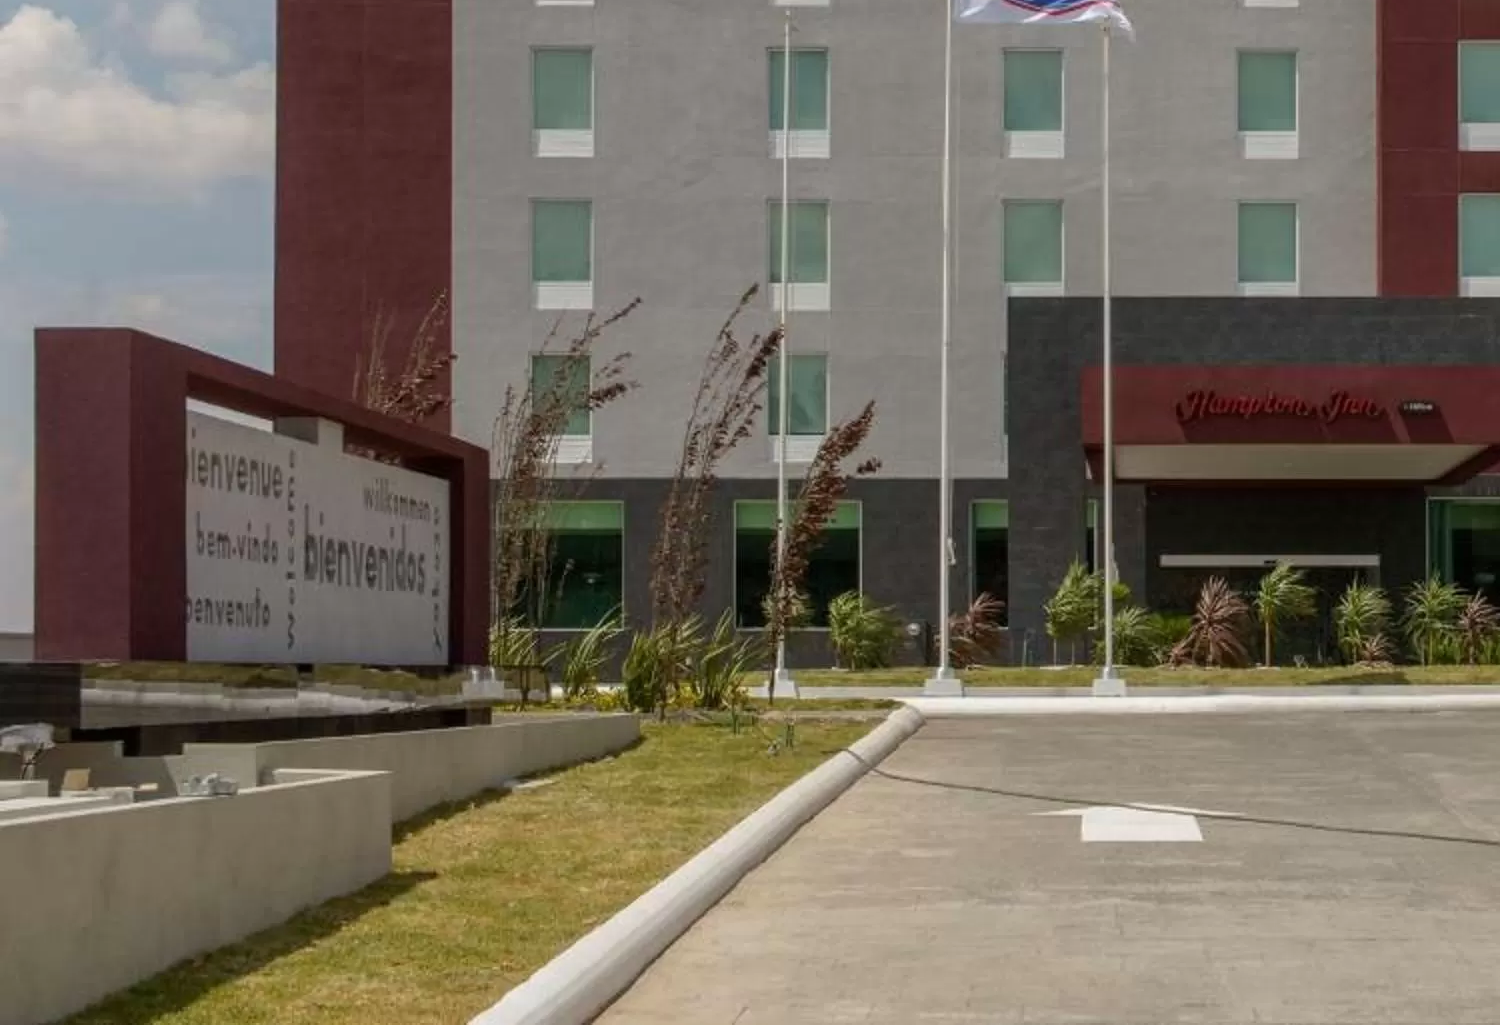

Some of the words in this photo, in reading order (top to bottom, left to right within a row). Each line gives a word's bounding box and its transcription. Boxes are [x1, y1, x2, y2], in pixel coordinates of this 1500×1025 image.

[1176, 388, 1313, 423] Hampton
[1321, 387, 1382, 423] Inn
[187, 426, 283, 499] ienvenue
[303, 502, 425, 595] bienvenidos
